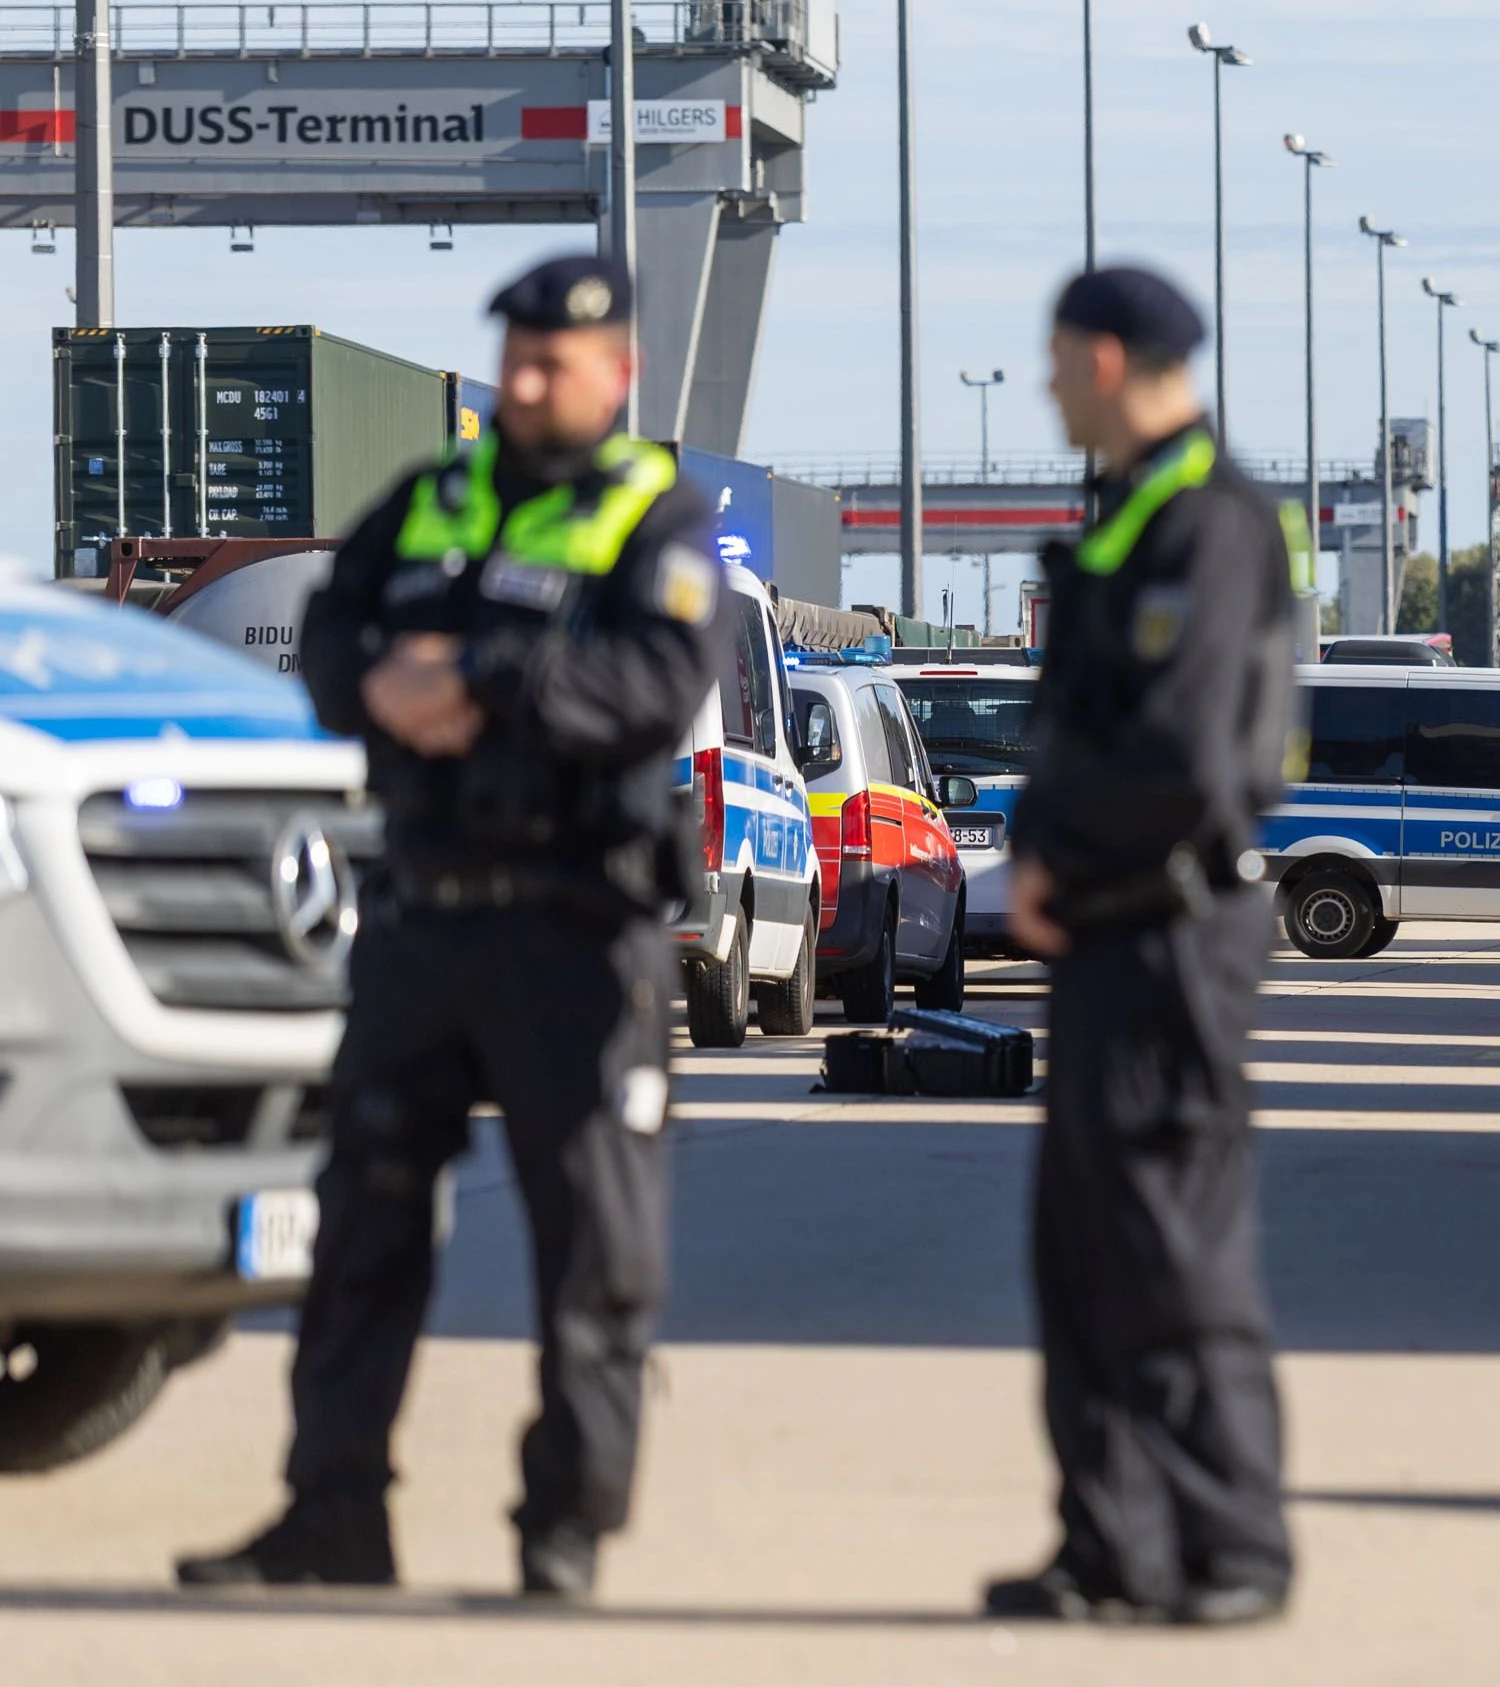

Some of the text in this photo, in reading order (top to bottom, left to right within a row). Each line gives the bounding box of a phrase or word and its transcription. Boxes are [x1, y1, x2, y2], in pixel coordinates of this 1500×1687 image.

[124, 104, 485, 145] DUSS-Terminal
[637, 108, 717, 126] HILGERS
[216, 391, 241, 404] MCDU
[254, 390, 289, 403] 182401
[245, 626, 293, 645] BIDU
